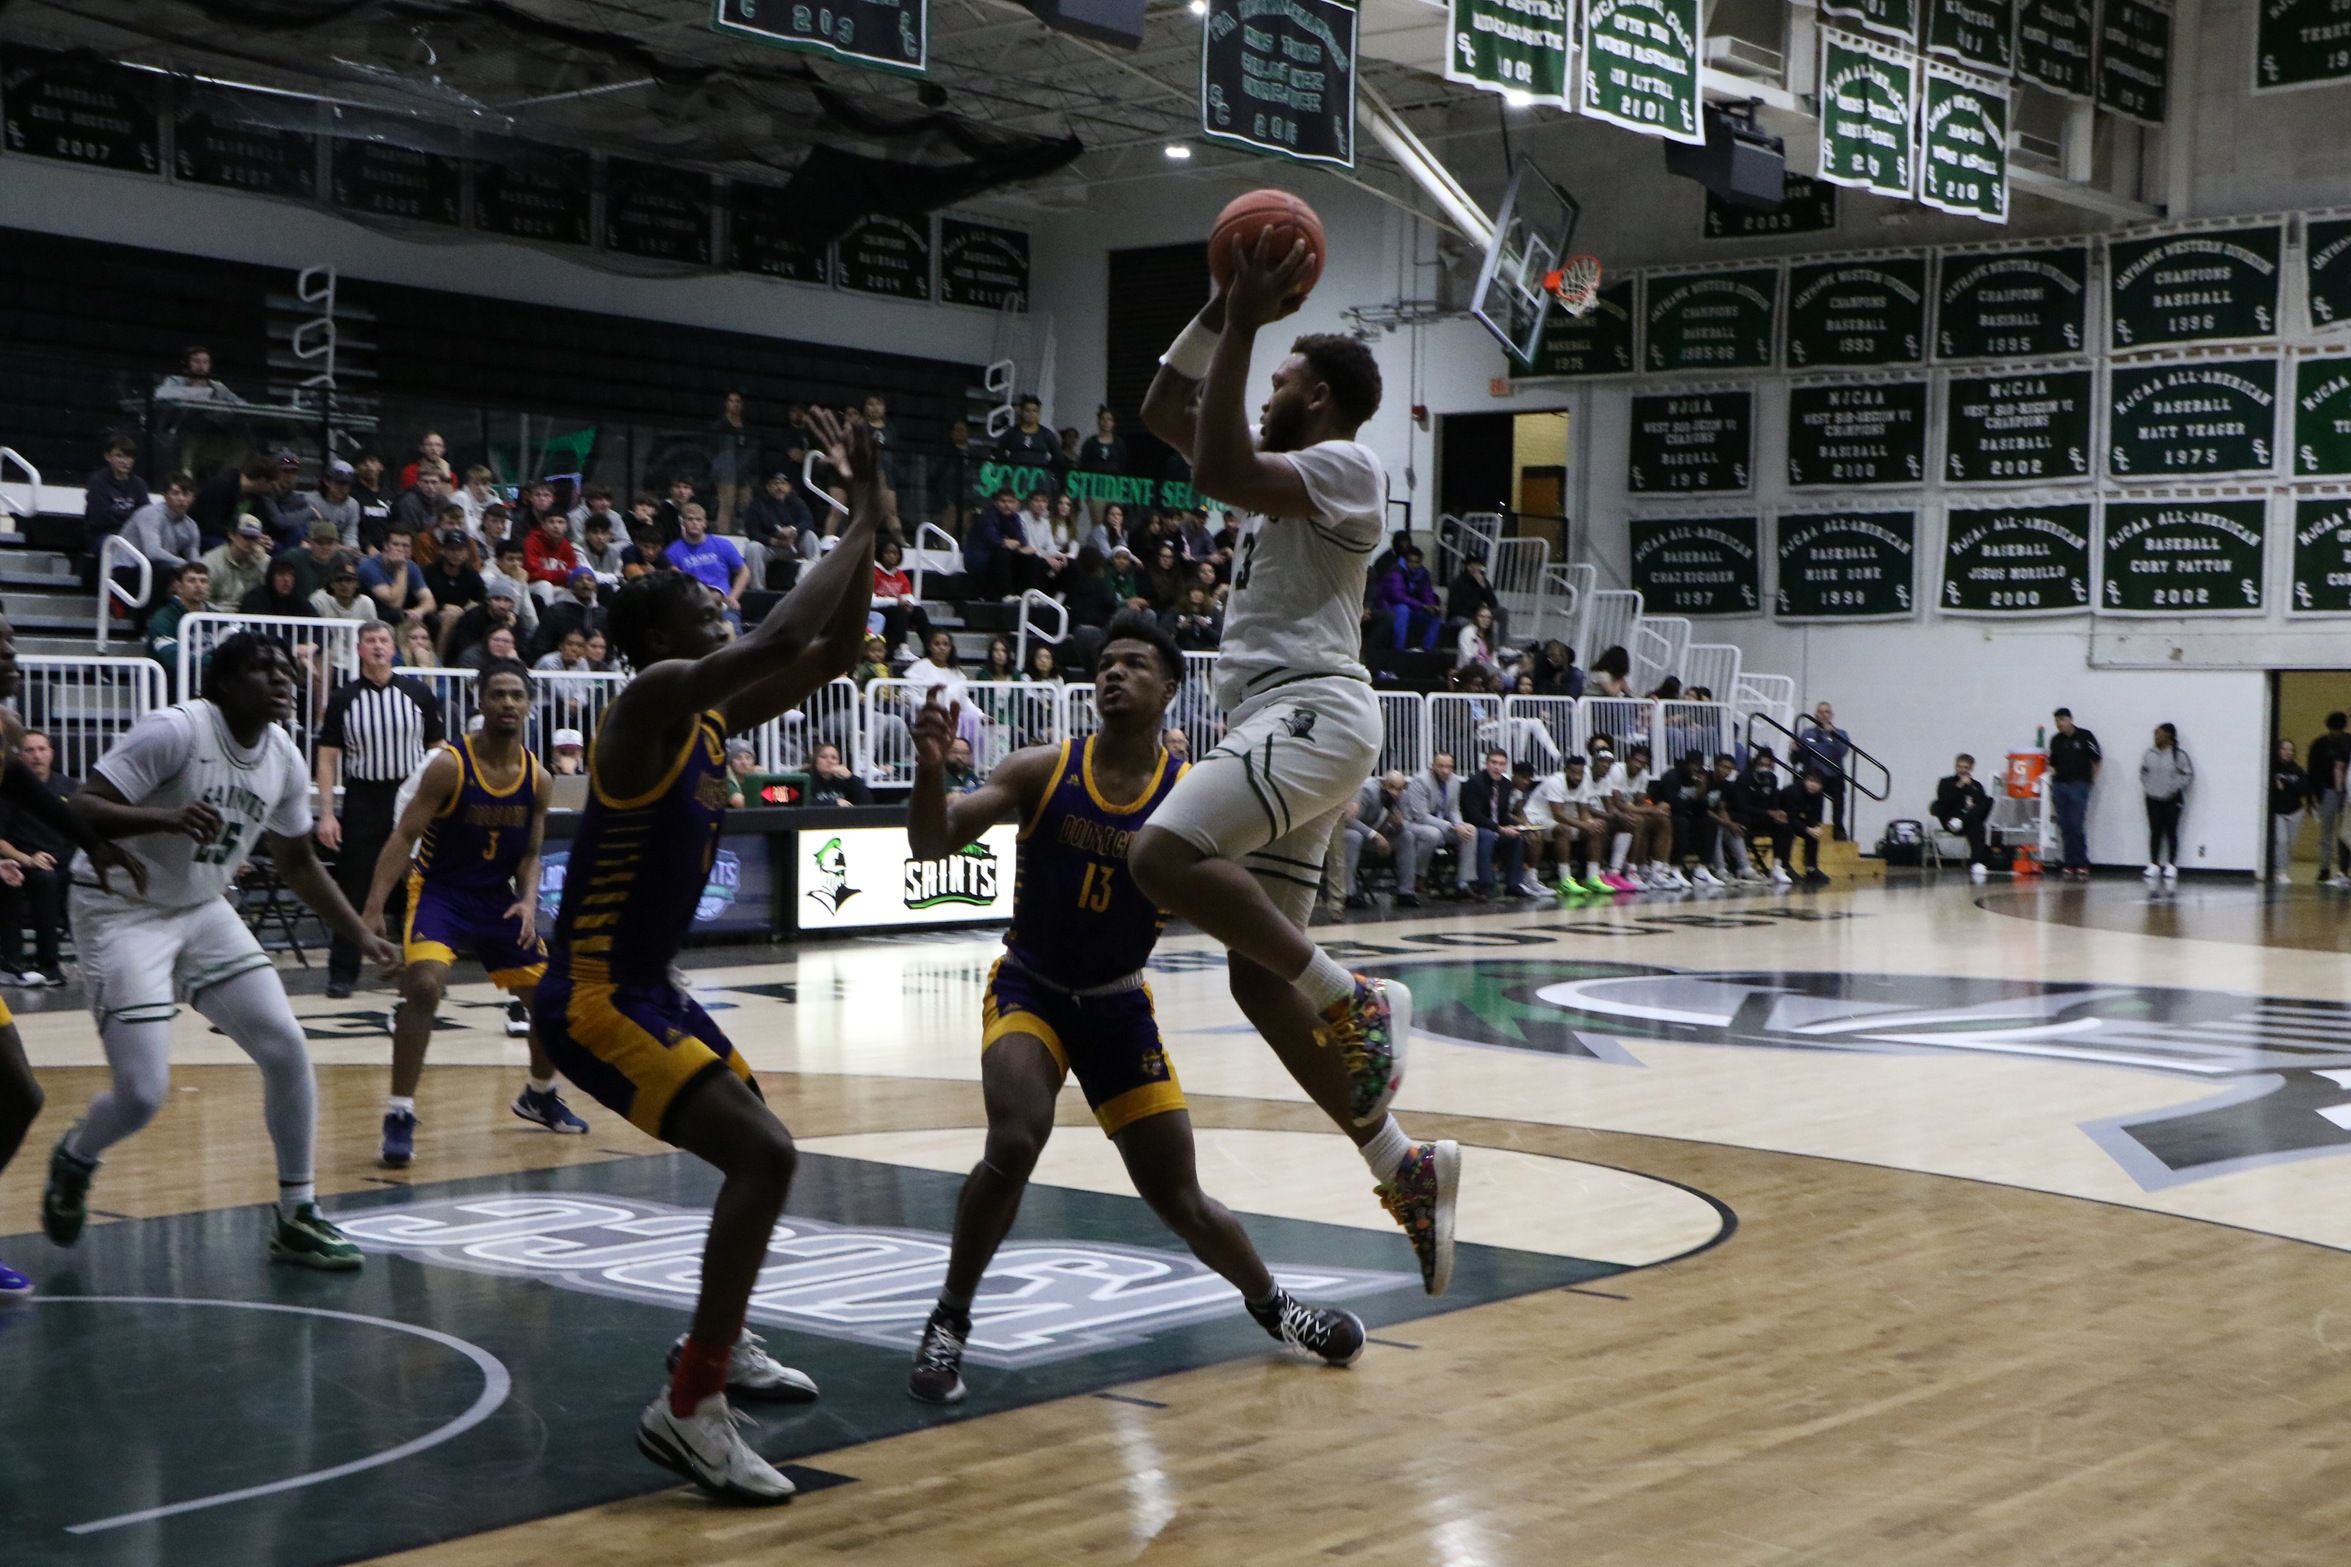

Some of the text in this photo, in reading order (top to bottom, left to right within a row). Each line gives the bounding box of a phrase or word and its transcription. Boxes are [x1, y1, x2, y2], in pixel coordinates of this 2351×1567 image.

[2114, 249, 2164, 291] JAYHAWK
[2162, 239, 2224, 258] WESTERN
[1944, 265, 1990, 304] JAYHAWK
[2153, 267, 2232, 286] CHAMPIONS
[1794, 274, 1837, 311] JAYHAWK
[1977, 288, 2045, 303] CHAMPIONS
[2152, 291, 2233, 309] BASEBALL
[1828, 297, 1888, 310] CHAMPIONS
[1825, 318, 1888, 332] BASEBALL
[1978, 313, 2041, 328] BASEBALL
[2167, 315, 2215, 334] 1996
[1682, 328, 1737, 341] BASEBALL
[1987, 337, 2032, 353] 1995
[1988, 381, 2048, 398] NJCAA
[2114, 370, 2275, 417] NJCAA ALL-AMERICAN
[2300, 375, 2350, 412] NJCAA
[1828, 392, 1886, 406] NJCAA
[1962, 405, 1990, 419] WEST
[2152, 399, 2233, 417] BASEBALL
[1984, 415, 2051, 430] CHAMPIONS
[2137, 423, 2246, 443] MATT YEAGER
[1818, 446, 1889, 460] BASEBALL
[1979, 436, 2053, 453] BASEBALL
[2164, 449, 2219, 466] 1975
[1989, 459, 2043, 476] 2002
[1065, 468, 1156, 506] STUDENT
[1949, 516, 2087, 556] NJCAA ALL-AMERICAN
[2107, 511, 2262, 551] NJCAA ALL-AMERICAN
[2297, 512, 2345, 547] NJCAA
[1778, 518, 1911, 559] NJCAA ALL-AMERICAN
[2143, 538, 2221, 553] BASEBALL
[1634, 533, 1668, 562] NJCAA
[1809, 547, 1879, 560] BASEBALL
[1980, 543, 2051, 558] BASEBALL
[1662, 551, 1722, 563] BASEBALL
[2129, 559, 2232, 574] CORY PATTON
[1819, 590, 1866, 605] 1998
[2152, 588, 2210, 605] 2002
[905, 854, 997, 902] SAINTS
[1077, 861, 1115, 913] 13
